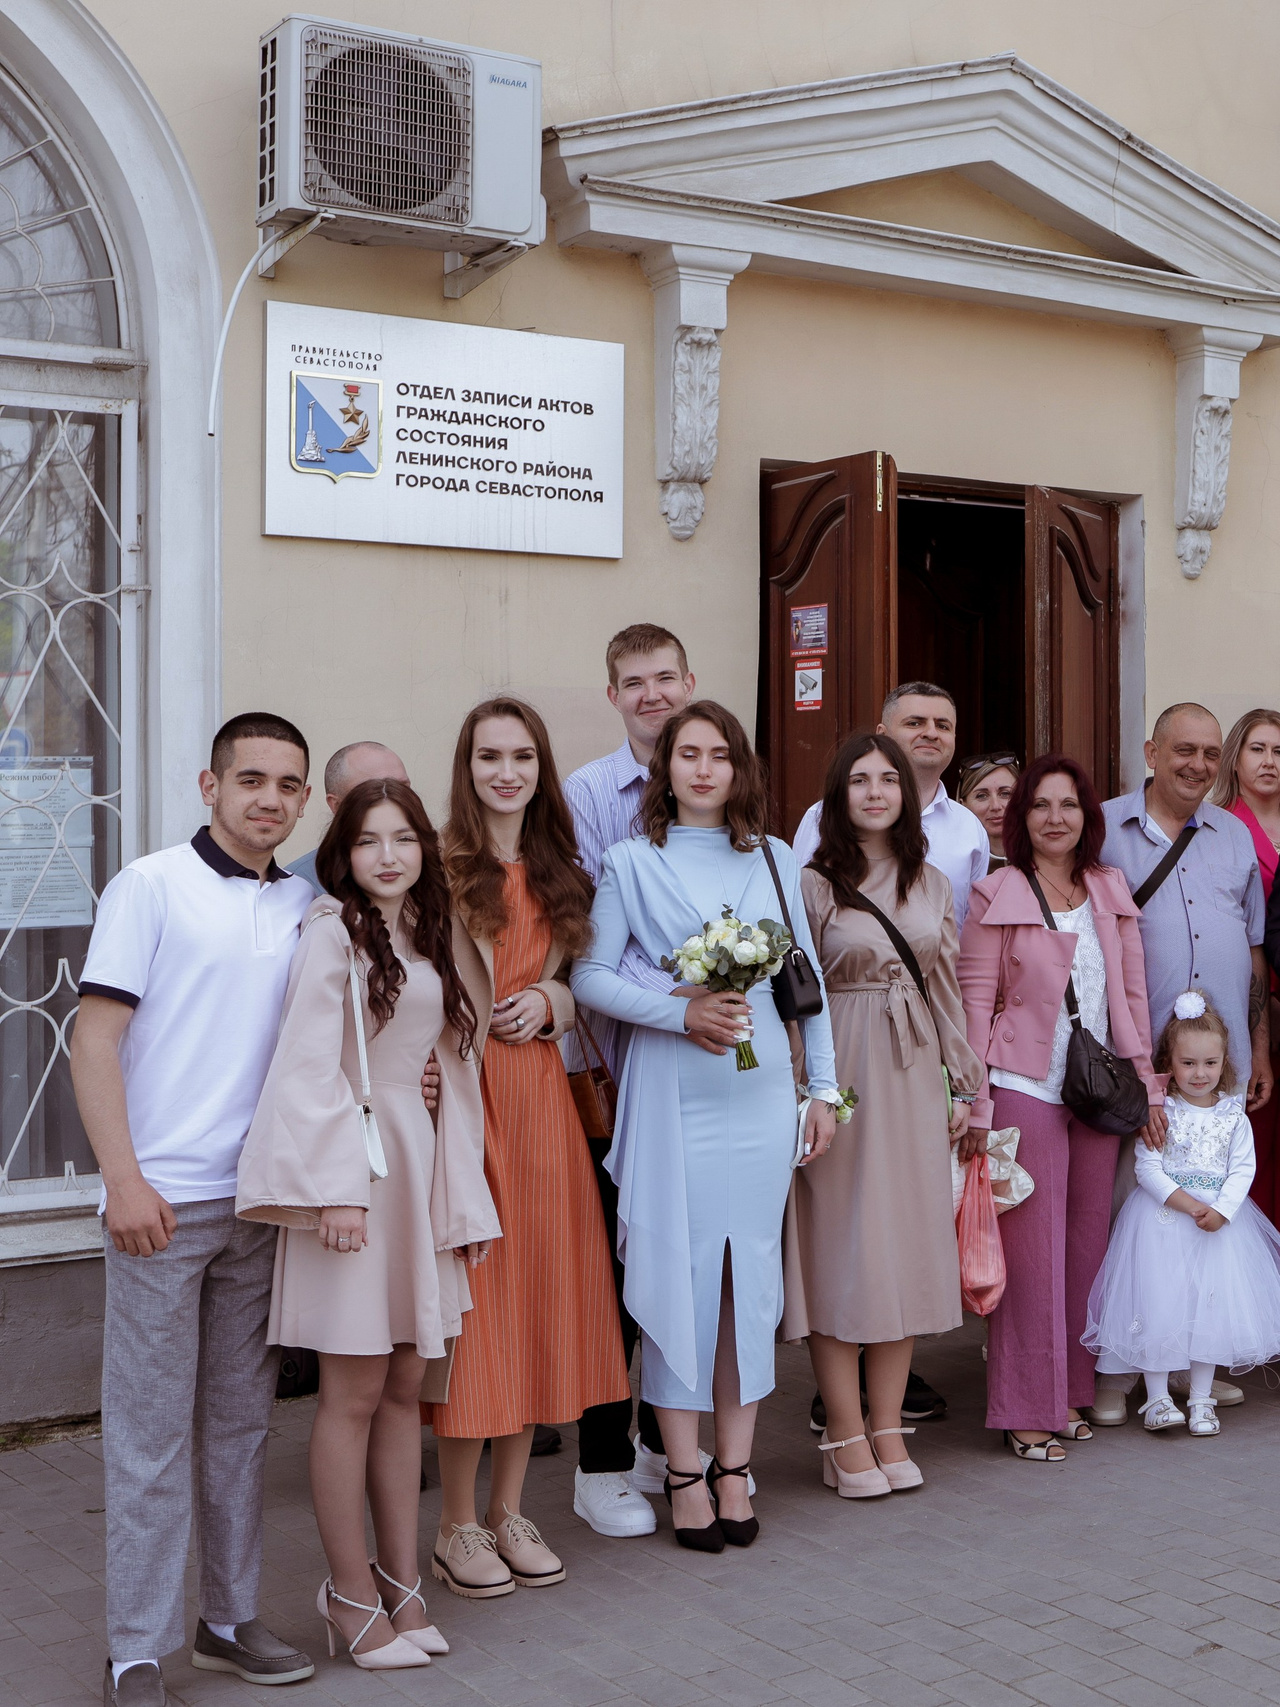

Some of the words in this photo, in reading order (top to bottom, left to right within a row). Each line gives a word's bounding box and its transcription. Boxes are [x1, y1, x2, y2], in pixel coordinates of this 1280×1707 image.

[489, 74, 527, 89] NIAGARA
[291, 344, 382, 362] ПРАВИТЕЛЬСТВО
[294, 355, 377, 372] СЕВАСТОПОЛЯ
[396, 382, 456, 401] ОТДЕЛ
[461, 389, 532, 410] ЗАПИСИ
[538, 398, 595, 416] АКТОВ
[396, 405, 546, 432] ГРАЖДАНСКОГО
[396, 428, 508, 451] СОСТОЯНИЯ
[395, 451, 518, 475] ЛЕНИНСКОГО
[523, 459, 593, 481] РАЙОНА
[395, 473, 470, 493] ГОРОДА
[475, 480, 604, 503] СЕВАСТОПОЛЯ
[0, 773, 29, 781] Режим
